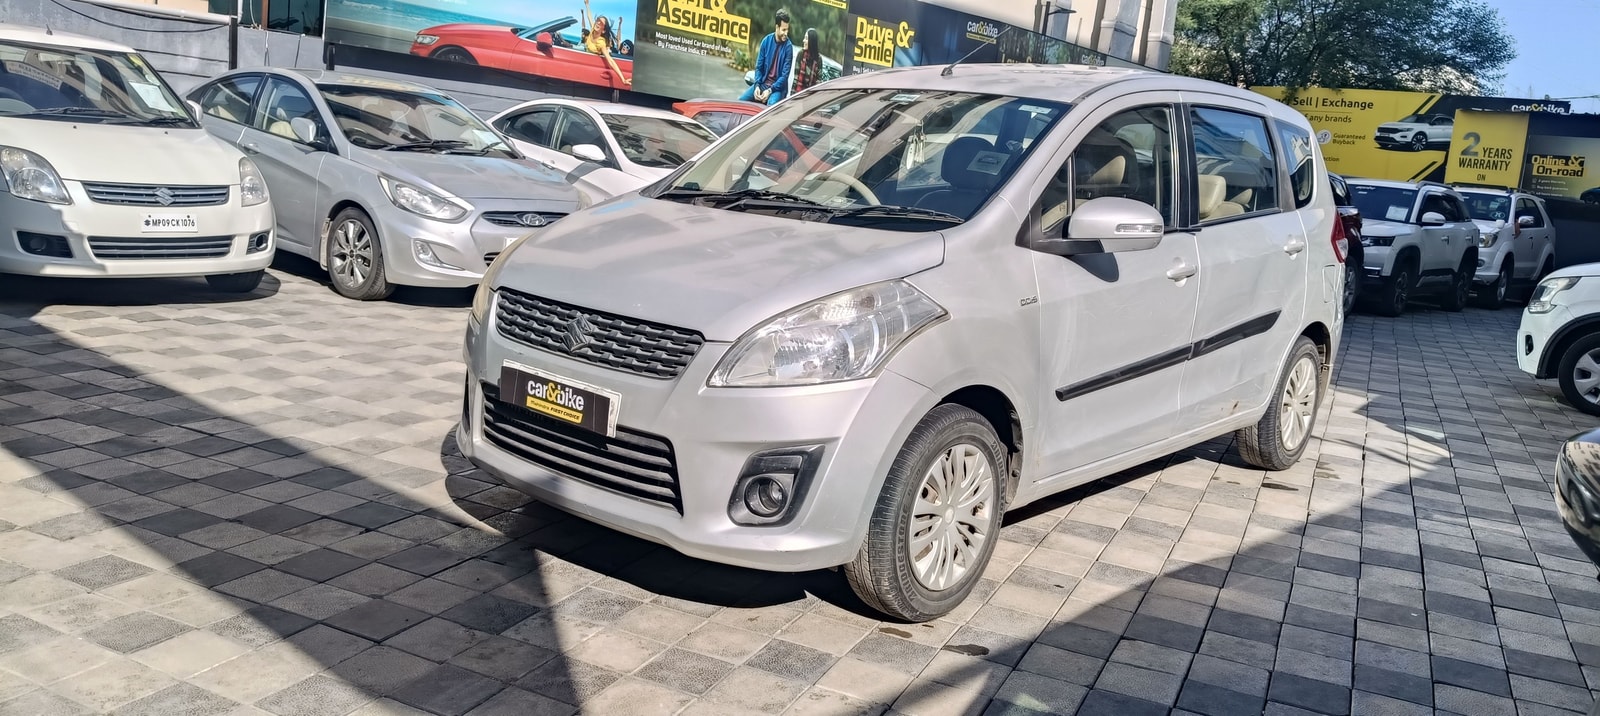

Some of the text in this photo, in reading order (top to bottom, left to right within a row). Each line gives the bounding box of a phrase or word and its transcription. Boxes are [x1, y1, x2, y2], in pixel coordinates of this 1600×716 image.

[658, 0, 748, 39] Assurance
[857, 16, 915, 48] Drive &
[967, 21, 998, 37] car&bike
[666, 42, 687, 52] Franchise
[702, 41, 714, 49] brand
[855, 38, 892, 63] Smile
[1293, 97, 1312, 106] Sell
[1322, 98, 1374, 110] Exchange
[1325, 114, 1351, 123] brands
[1460, 132, 1512, 159] 2 YEARS
[1459, 158, 1510, 171] WARRANTY
[1532, 155, 1585, 167] Online &
[1537, 166, 1584, 177] On-road
[528, 380, 584, 410] car&bike
[563, 412, 579, 420] CHOICE
